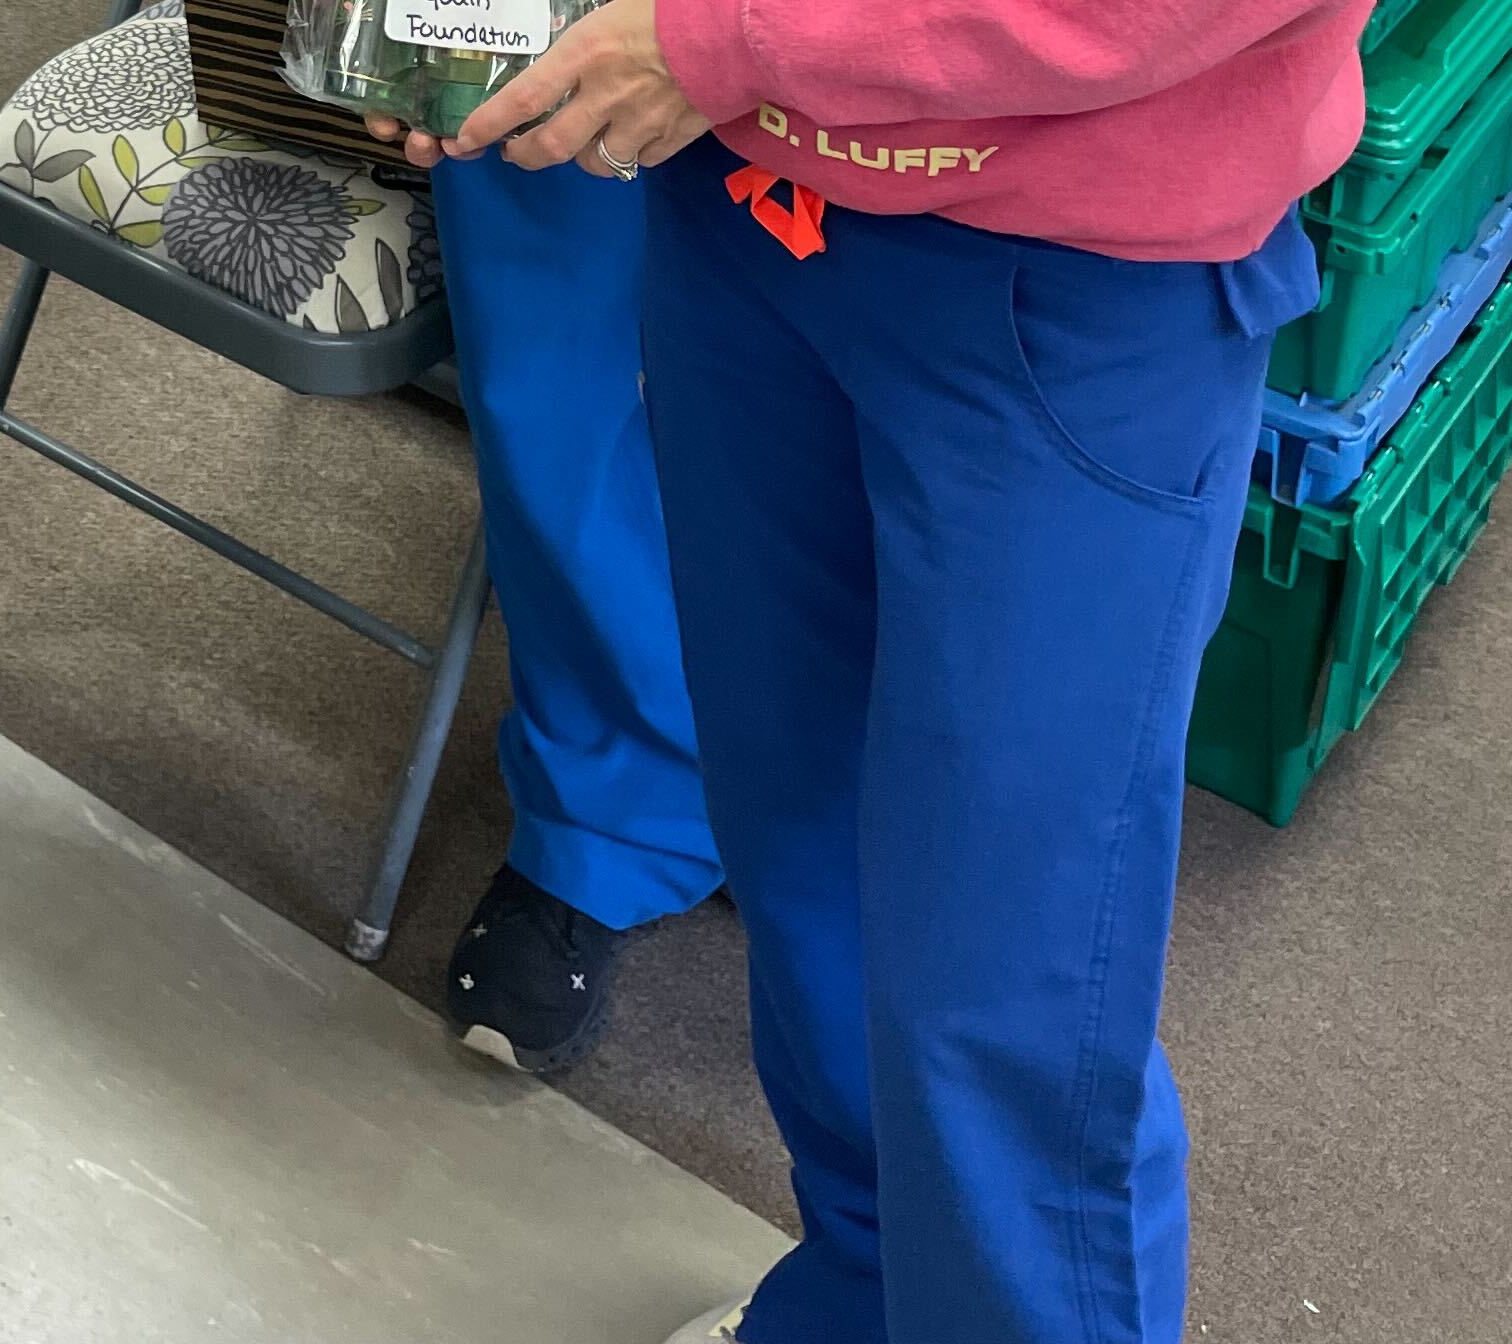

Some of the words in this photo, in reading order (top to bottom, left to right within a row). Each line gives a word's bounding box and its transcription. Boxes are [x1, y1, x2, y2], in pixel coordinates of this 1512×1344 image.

[406, 14, 530, 47] Foundation
[758, 102, 801, 147] D.
[816, 128, 1000, 178] LUFFY
